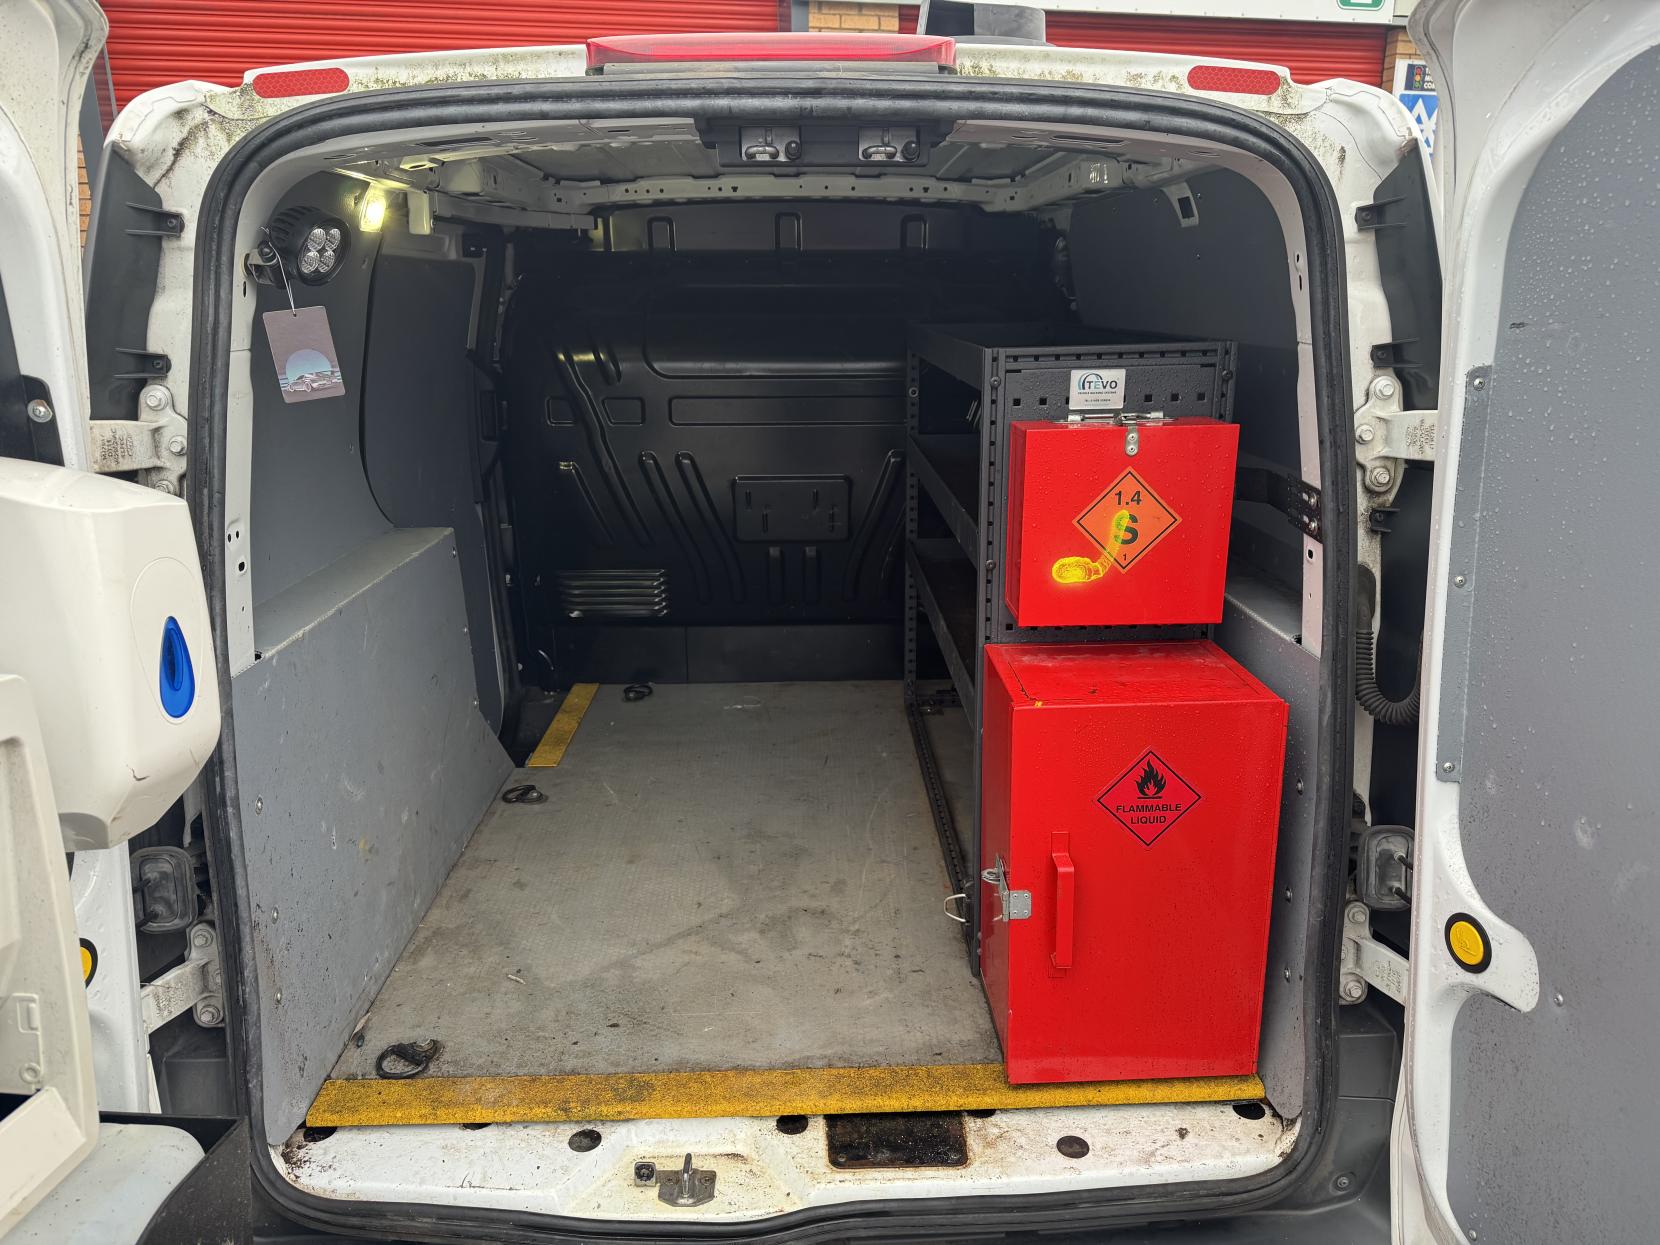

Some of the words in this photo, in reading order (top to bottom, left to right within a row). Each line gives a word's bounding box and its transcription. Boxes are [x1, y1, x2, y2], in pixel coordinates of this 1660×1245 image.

[1086, 380, 1118, 390] TEVO
[1115, 490, 1142, 506] 1.4
[1114, 513, 1139, 545] S
[1122, 553, 1128, 561] 1
[1116, 804, 1182, 813] FLAMMABLE
[1130, 815, 1167, 824] LIQUID
